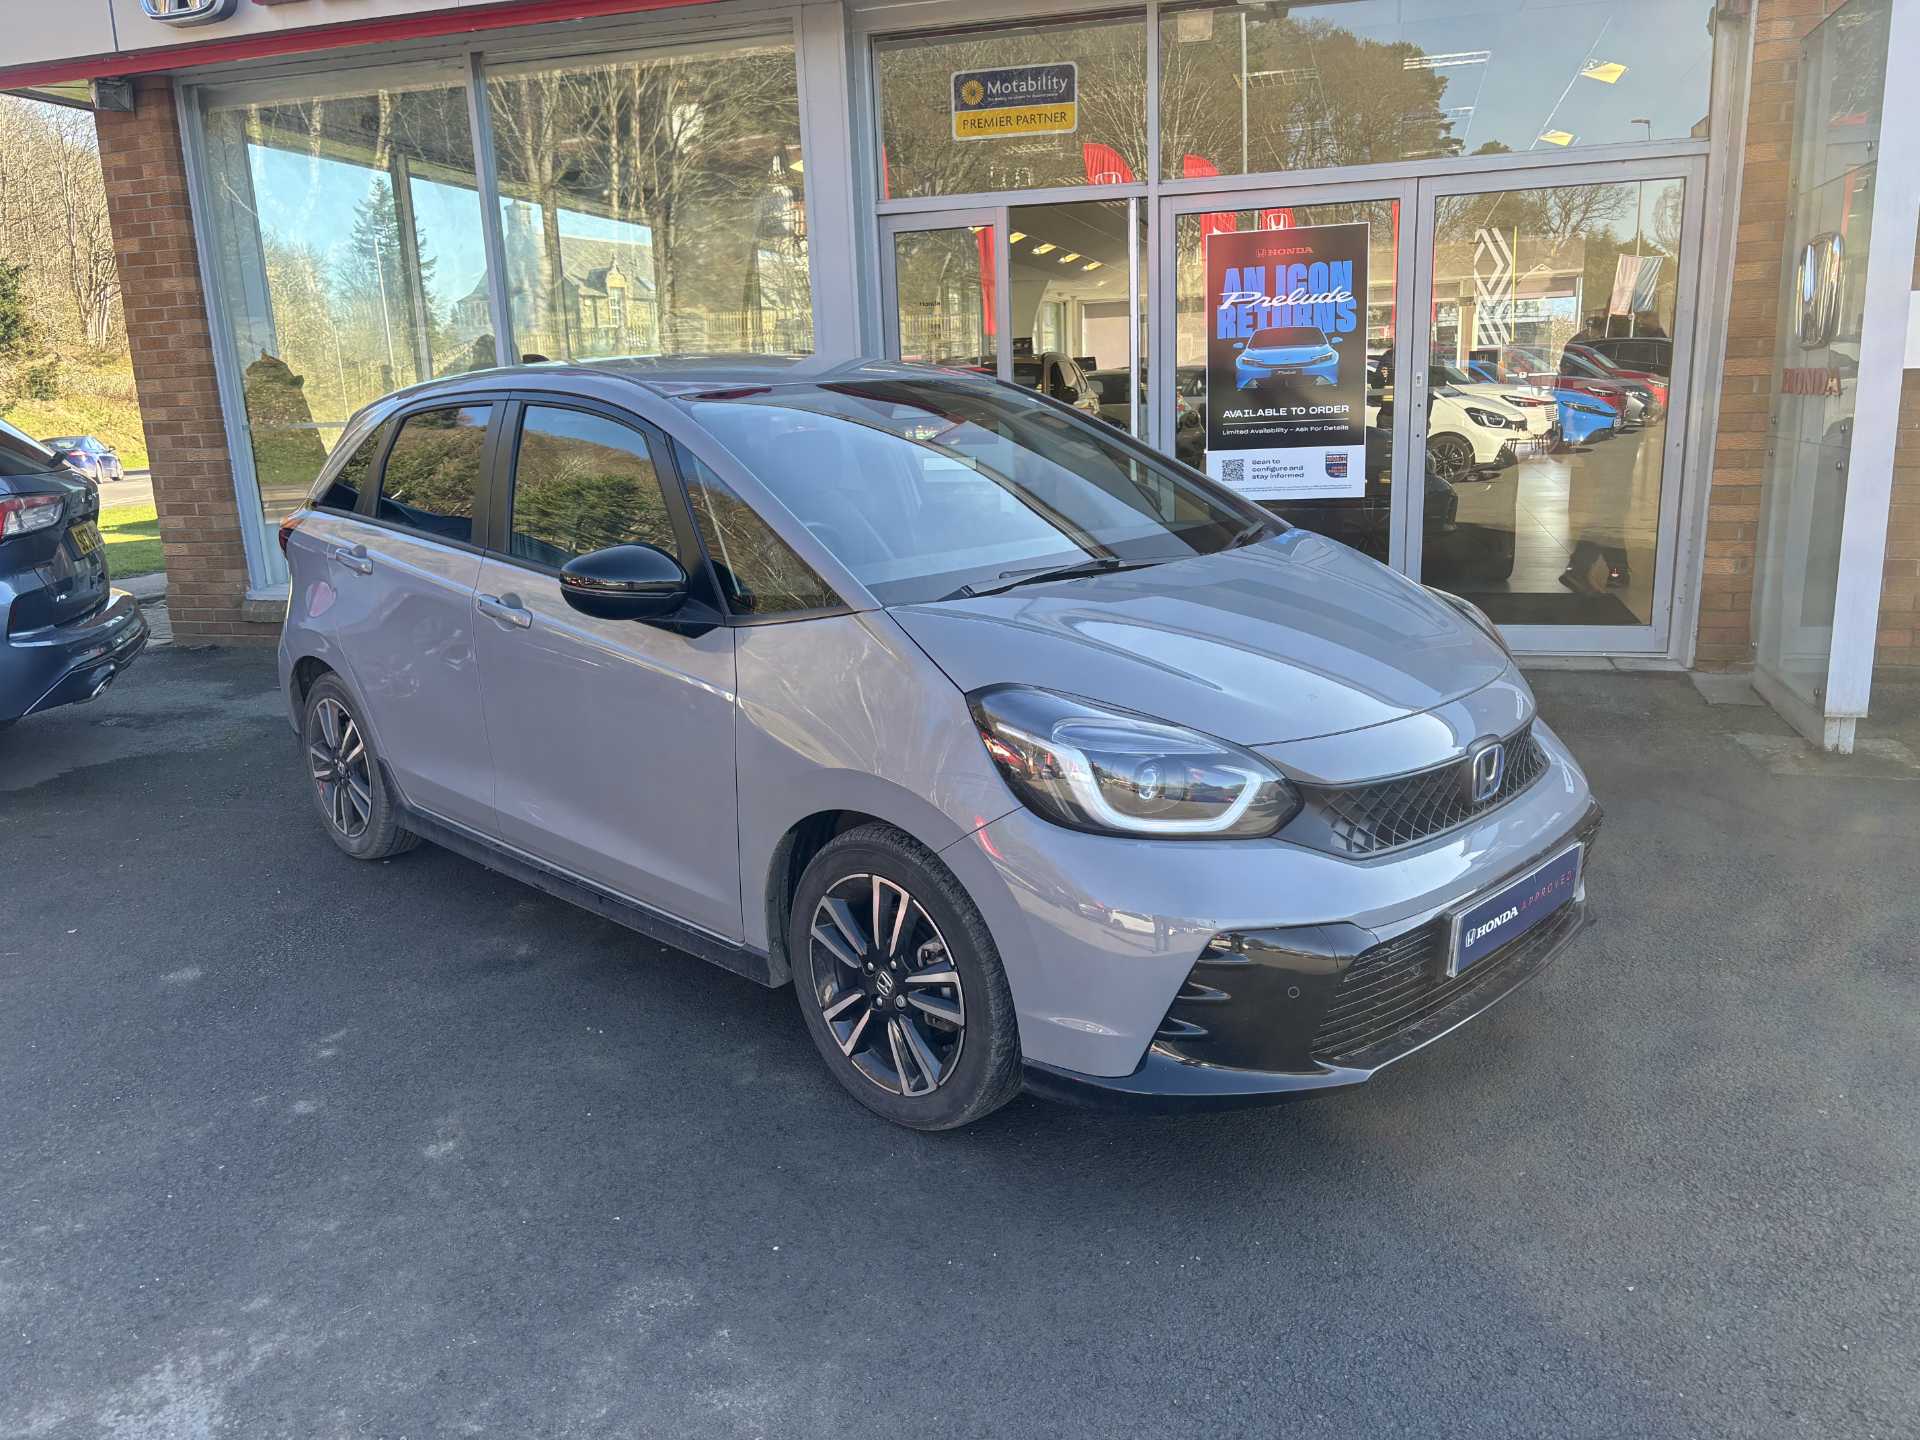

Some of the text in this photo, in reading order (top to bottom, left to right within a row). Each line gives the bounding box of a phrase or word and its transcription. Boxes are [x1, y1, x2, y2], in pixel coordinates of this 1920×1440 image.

[987, 74, 1068, 94] Motability
[962, 111, 1067, 129] PREMIER PARTNER
[1268, 247, 1314, 257] HONDA
[1223, 260, 1353, 303] AN ICON
[1219, 286, 1353, 310] Prelude
[1216, 297, 1357, 339] RETURNS
[1783, 367, 1841, 397] HONDA
[1223, 405, 1350, 418] AVAILABLE TO ORDER
[1250, 427, 1288, 435] Availability
[1251, 465, 1288, 473] configure
[1476, 870, 1574, 939] HONDA APPROVED
